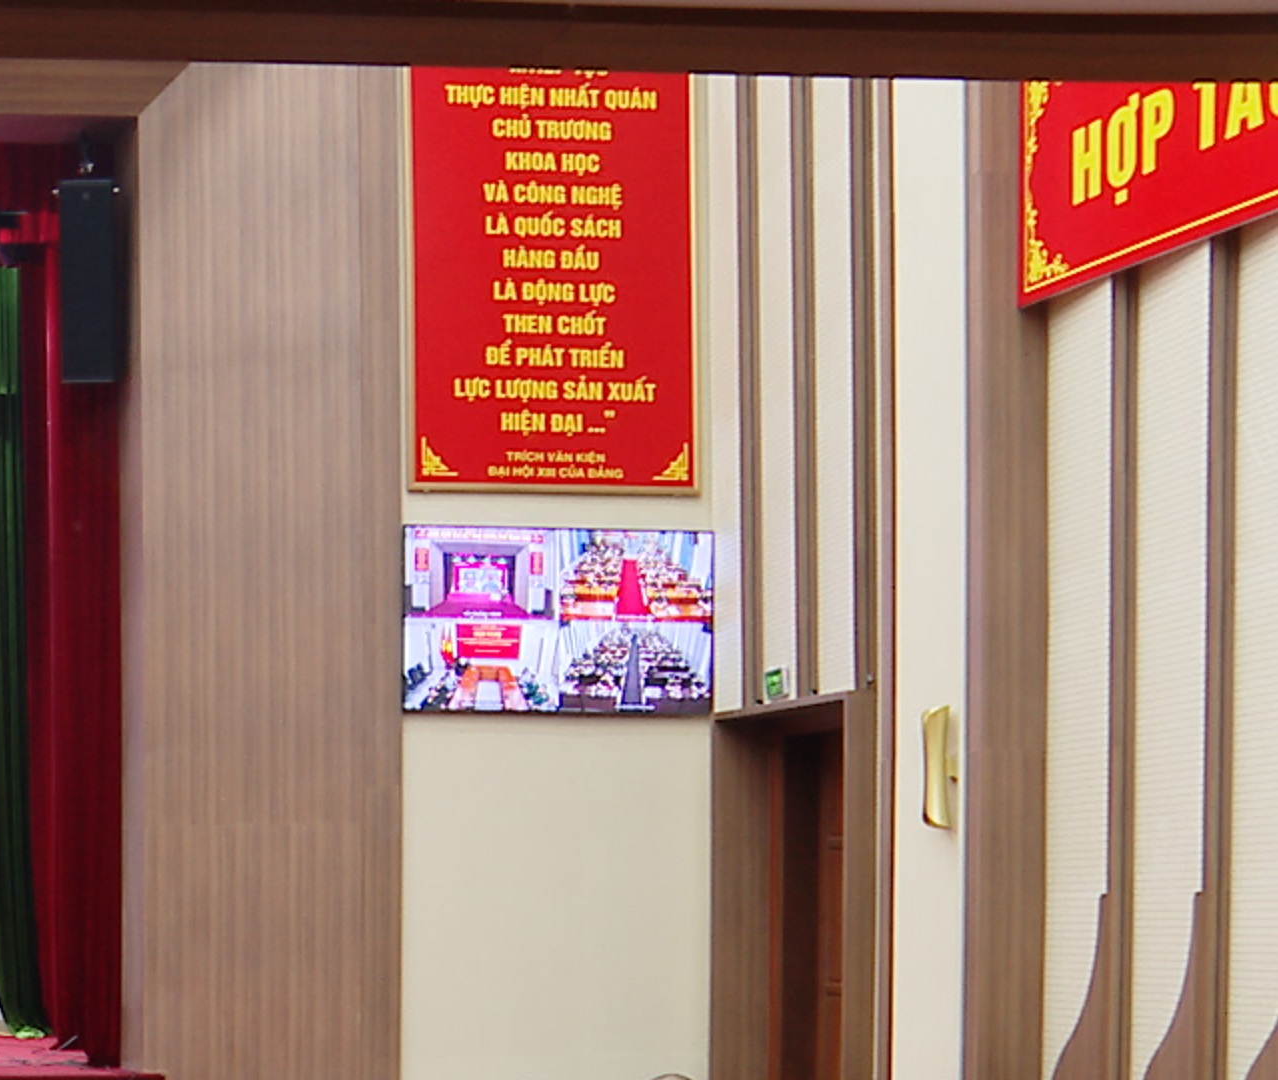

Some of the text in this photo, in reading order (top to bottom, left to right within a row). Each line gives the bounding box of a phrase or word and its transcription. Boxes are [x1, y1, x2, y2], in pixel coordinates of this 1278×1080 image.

[444, 82, 657, 111] THỰC HIỆN NHẤT QUÁN
[492, 113, 612, 141] CHỦ TRƯƠNG
[1072, 88, 1174, 206] HỢP
[505, 151, 600, 177] KHOA HỌC
[482, 179, 623, 211] VÀ CÔNG NGHỆ
[485, 210, 622, 239] LÀ QUỐC SÁCH
[502, 245, 556, 269] HÀNG
[493, 277, 616, 307] LÀ ĐỘNG LỰC
[502, 309, 607, 336] THEN CHỐT
[485, 338, 624, 369] ĐỂ PHÁT TRIỂN
[453, 374, 657, 403] LỰC LƯỢNG SẢN XUẤT
[500, 409, 583, 437] HIỆN ĐẠI
